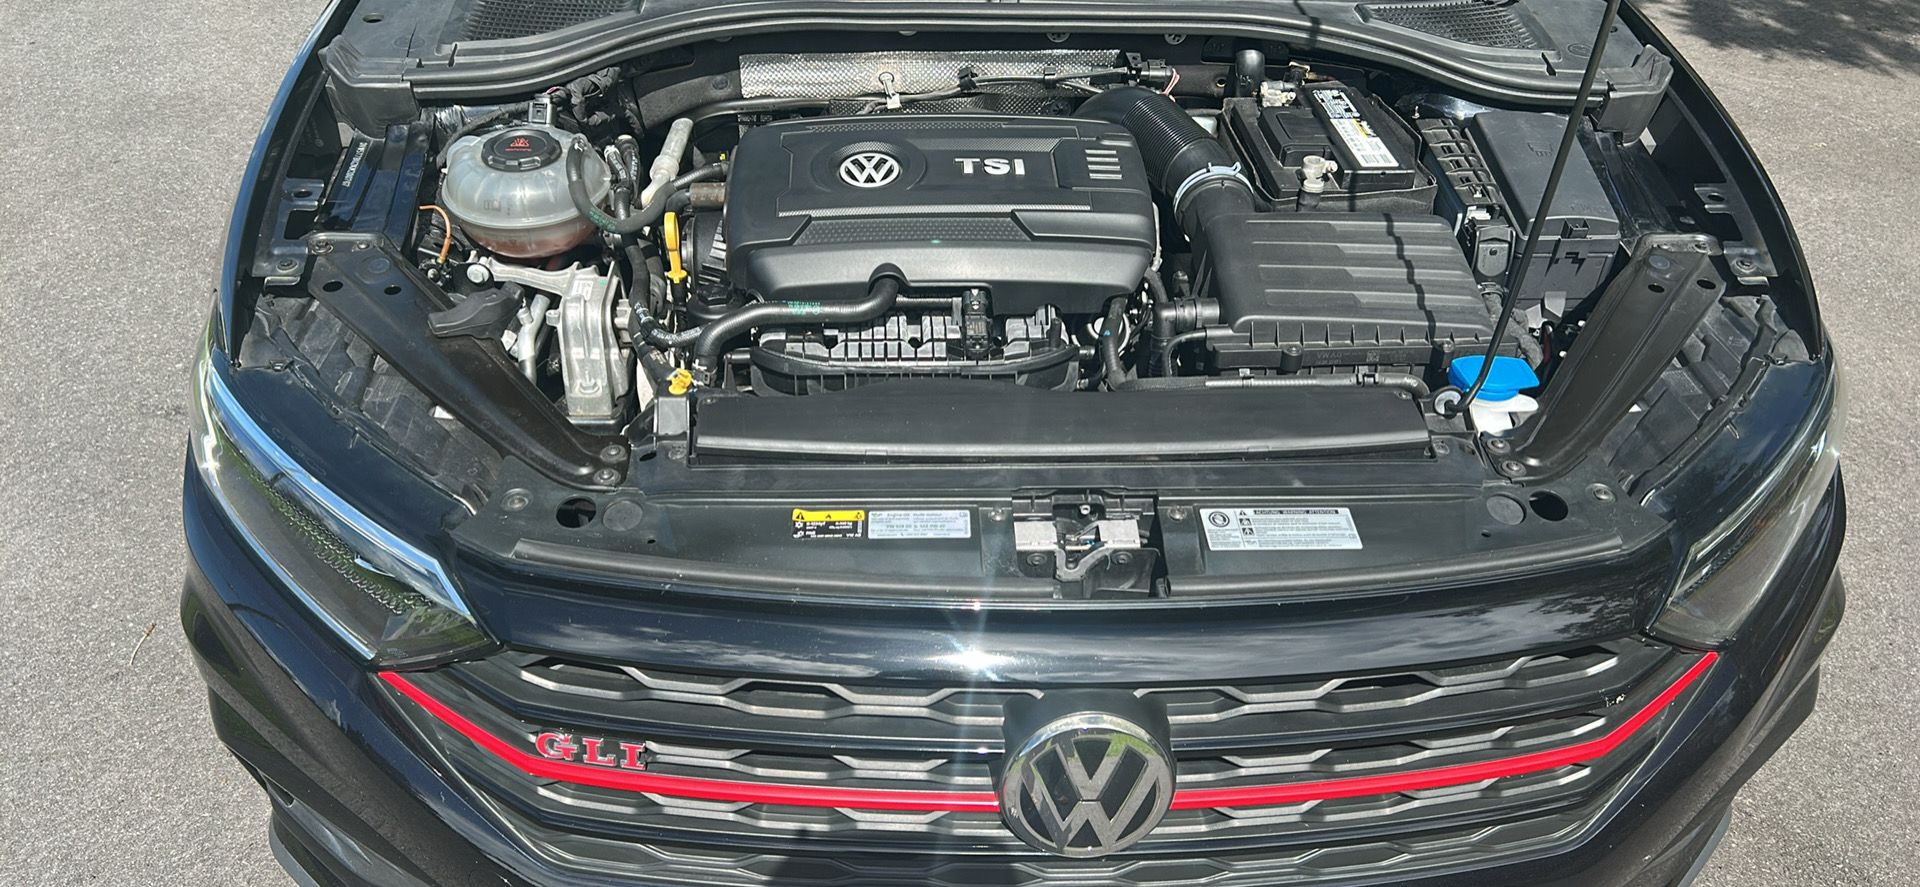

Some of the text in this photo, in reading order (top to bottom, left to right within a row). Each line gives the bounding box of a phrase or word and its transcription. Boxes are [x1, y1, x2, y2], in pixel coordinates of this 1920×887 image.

[839, 152, 900, 187] VW
[954, 157, 1026, 175] TSI
[535, 731, 647, 770] GLI
[1007, 718, 1172, 856] VW
